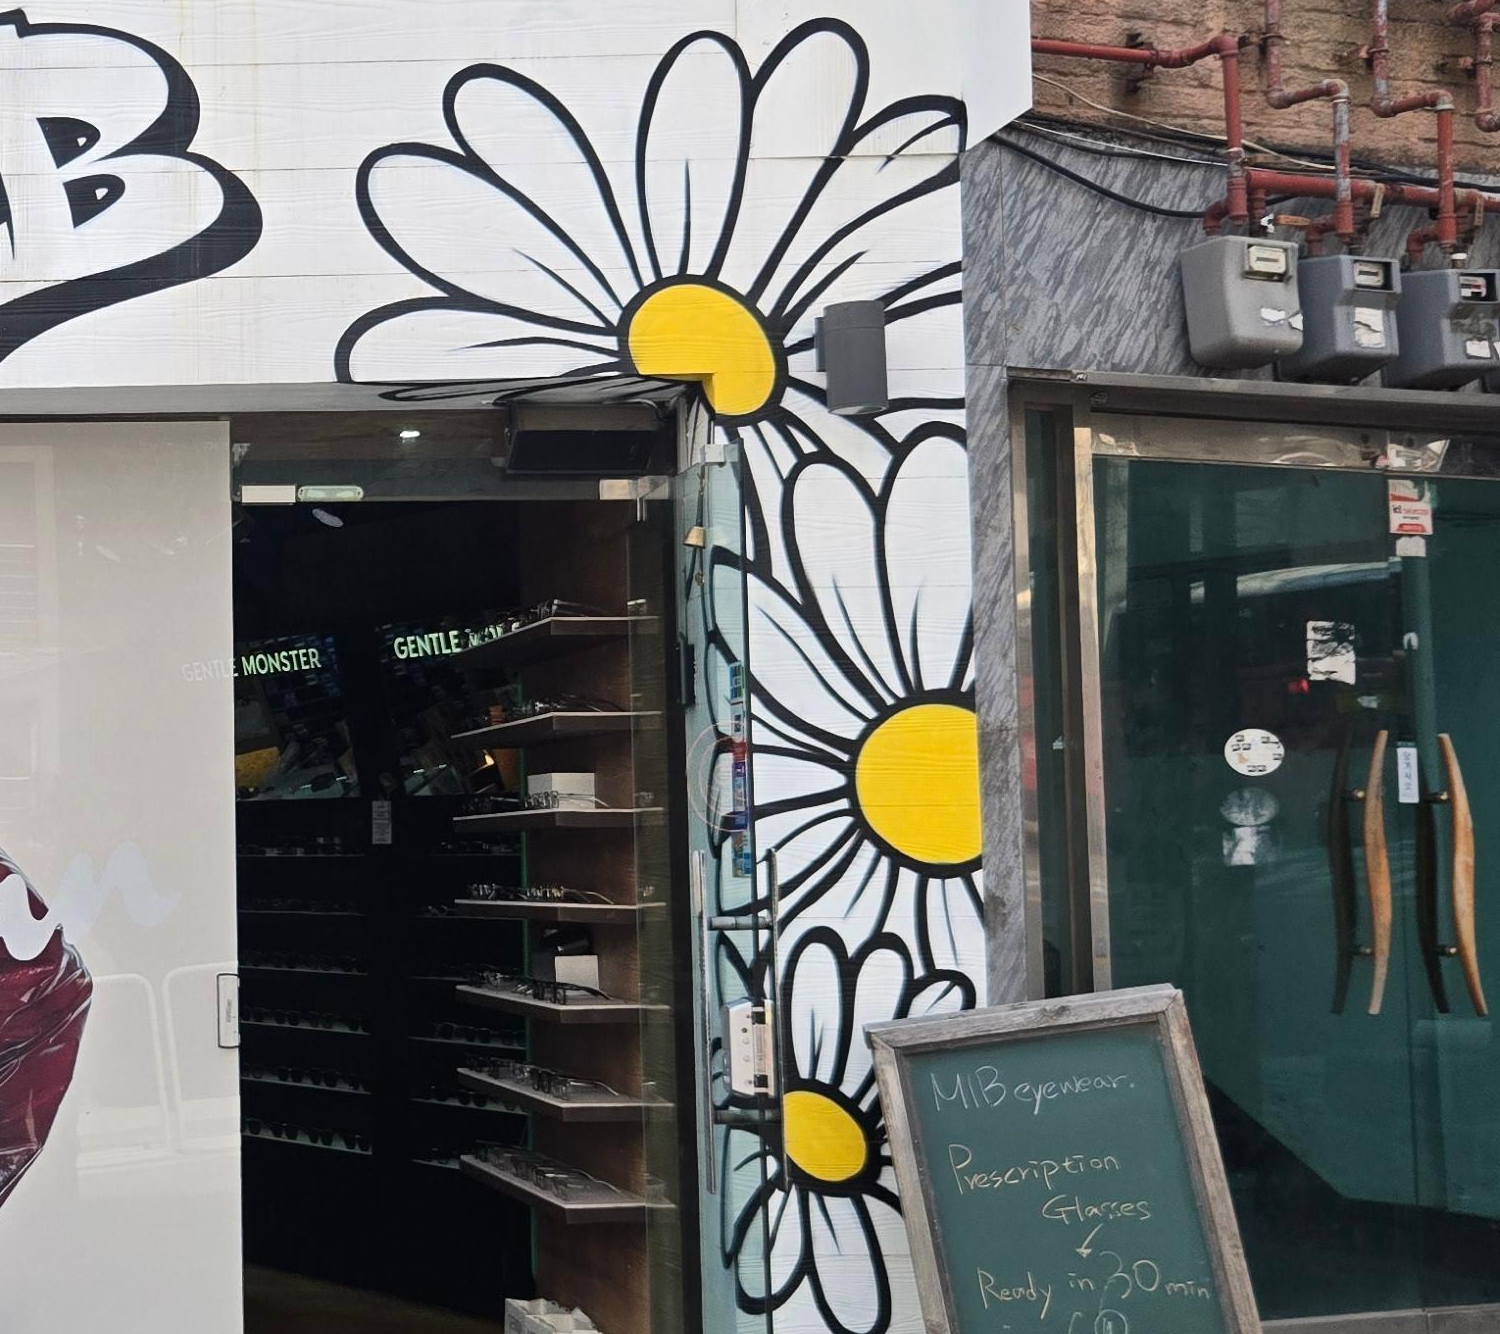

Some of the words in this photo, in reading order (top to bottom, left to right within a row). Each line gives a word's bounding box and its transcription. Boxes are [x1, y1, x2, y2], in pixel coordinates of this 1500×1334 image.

[241, 648, 322, 676] MONSTER
[393, 630, 463, 659] GENTLE
[931, 1066, 1007, 1111] MIB
[949, 1144, 1120, 1195] Prescription
[1042, 1195, 1151, 1224] Glasses
[977, 1267, 1051, 1319] Ready
[1067, 1272, 1094, 1291] in
[1100, 1251, 1160, 1299] 30
[1164, 1280, 1210, 1300] min
